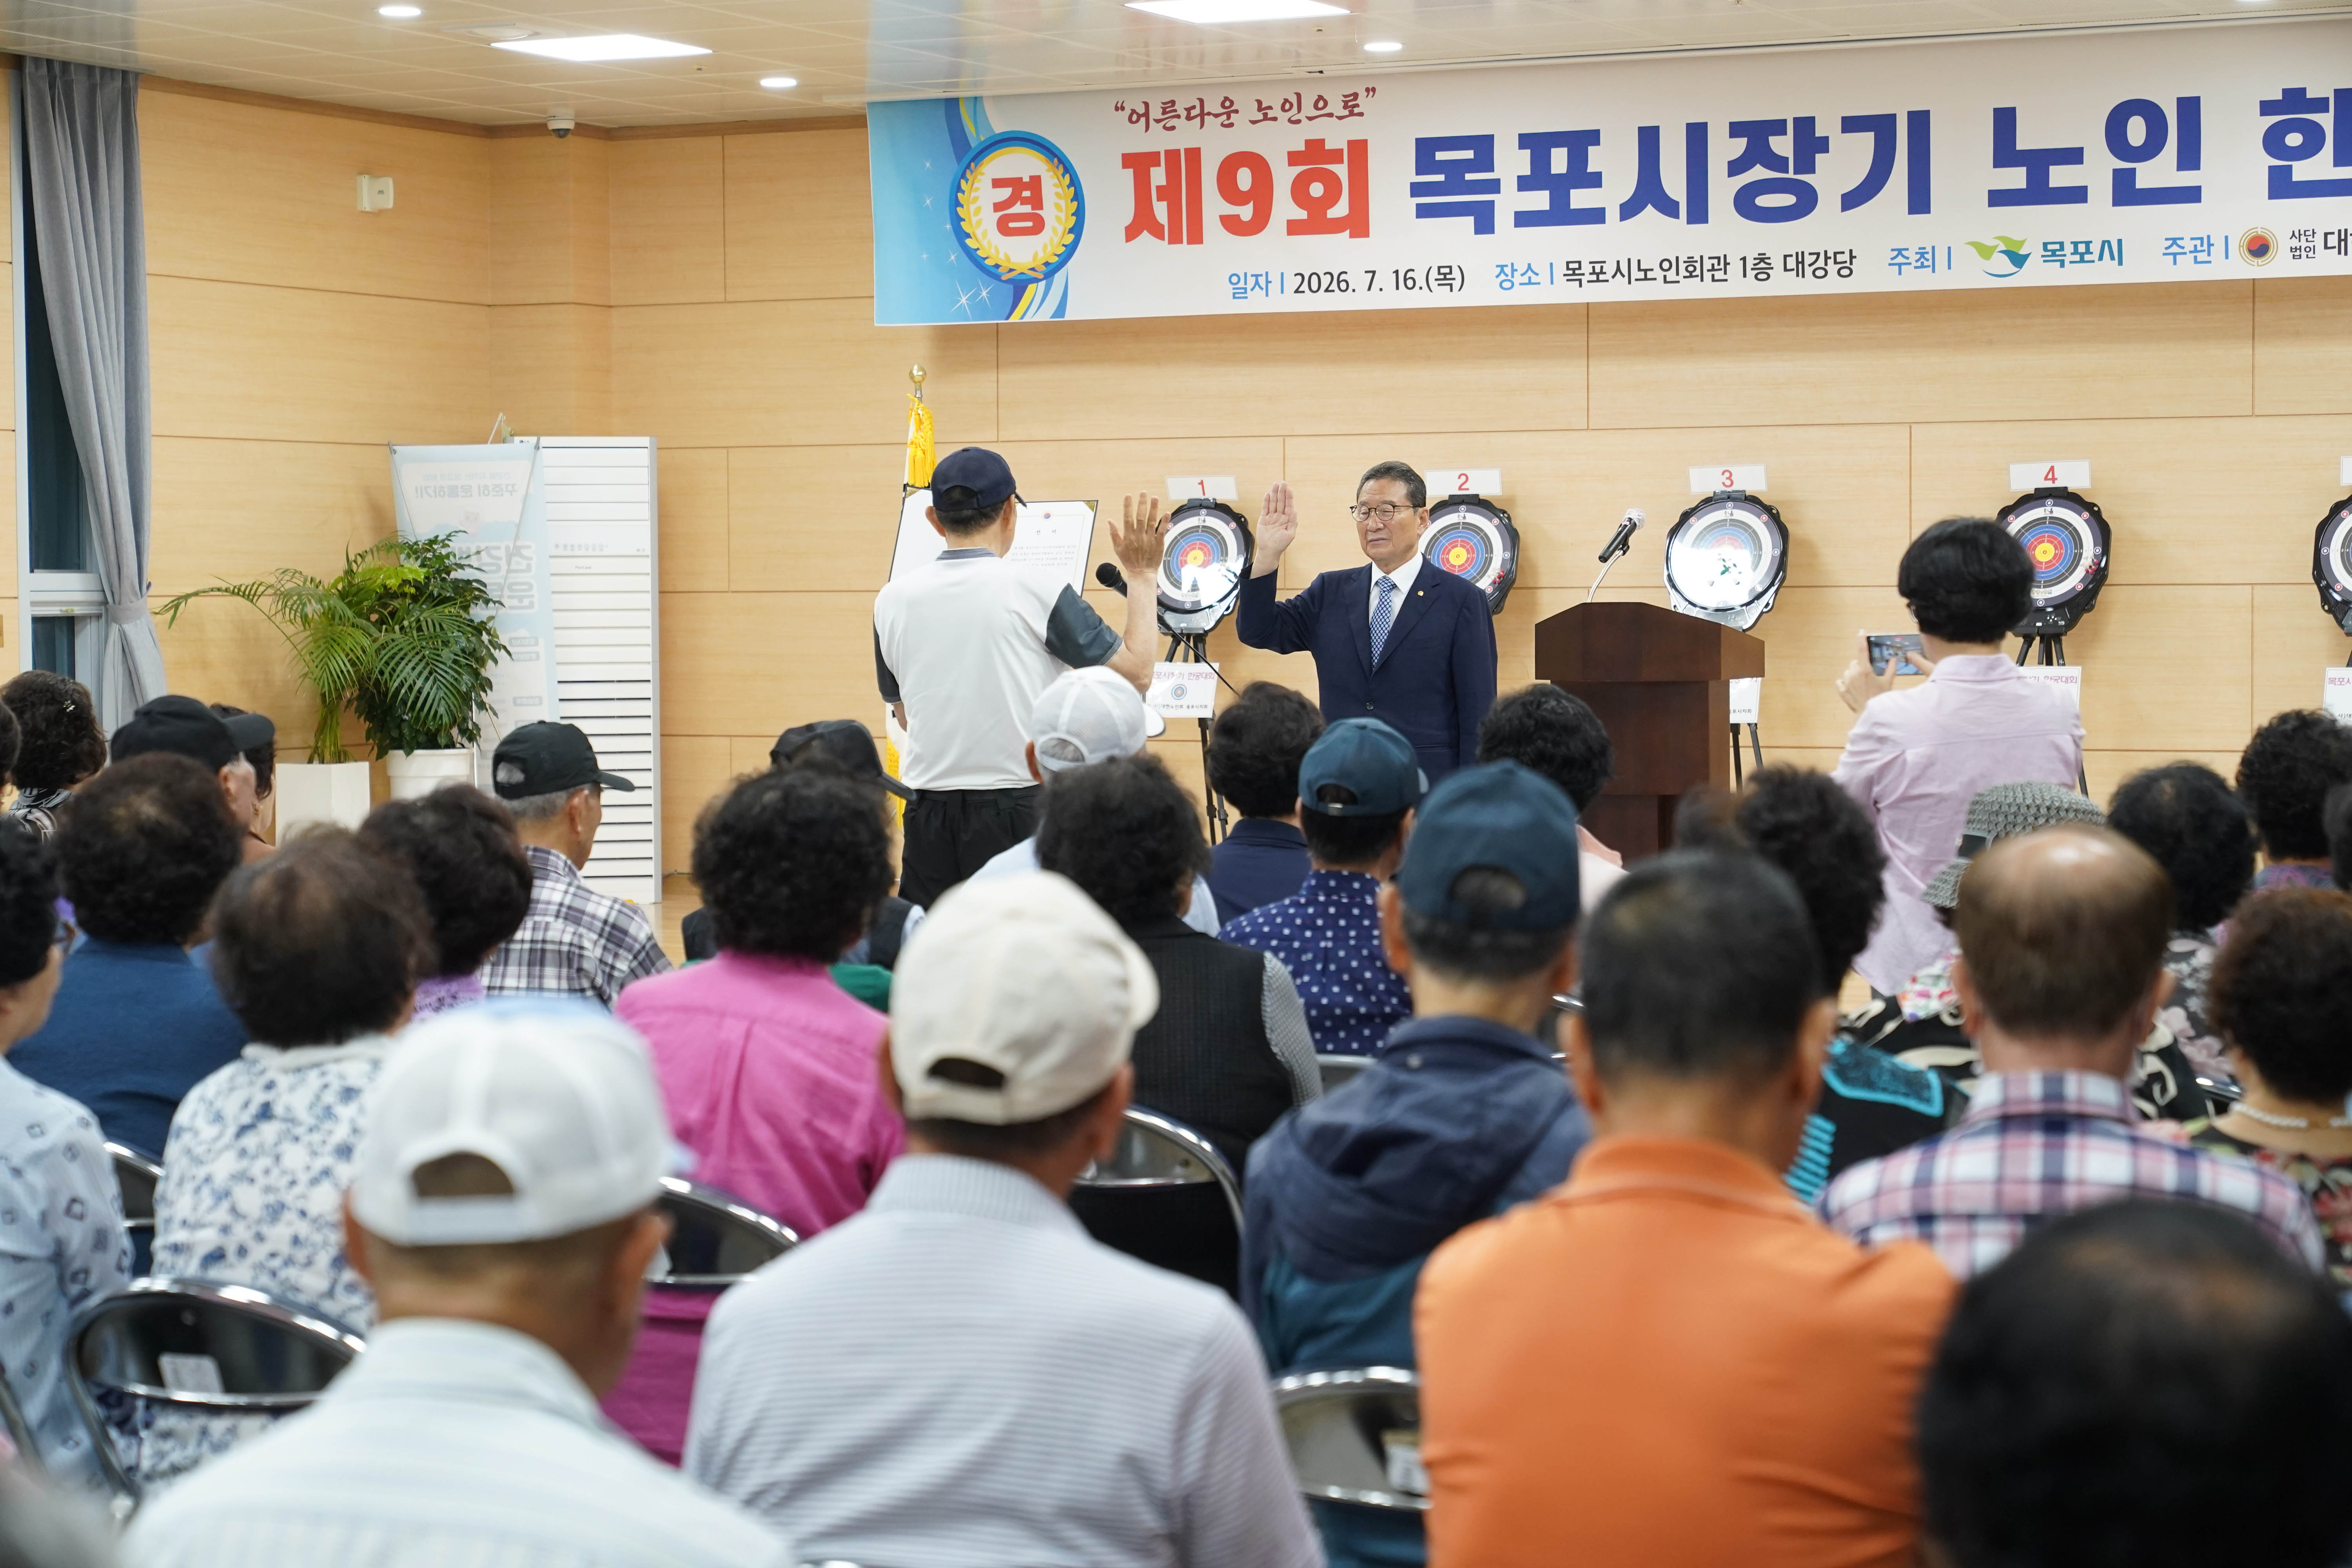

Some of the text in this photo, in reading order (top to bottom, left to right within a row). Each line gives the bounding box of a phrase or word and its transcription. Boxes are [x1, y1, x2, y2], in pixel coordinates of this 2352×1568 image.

[1121, 138, 1370, 245] 제9회
[1410, 109, 1931, 235] 목포시장기
[1988, 96, 2201, 207] 노인
[991, 175, 1045, 237] 경
[2290, 229, 2316, 243] 사단
[2324, 228, 2352, 256] 대
[2290, 245, 2316, 260] 법인
[1228, 235, 2214, 299] 일자 2026. 7. 16.(목) 장소 목포시노인회관 1층 대강당 주최 목포시 주관
[1458, 473, 1469, 490] 2
[1722, 470, 1733, 488] 3
[2044, 465, 2057, 484] 4
[1198, 479, 1205, 496] 1
[1188, 672, 1215, 681] 한궁대회
